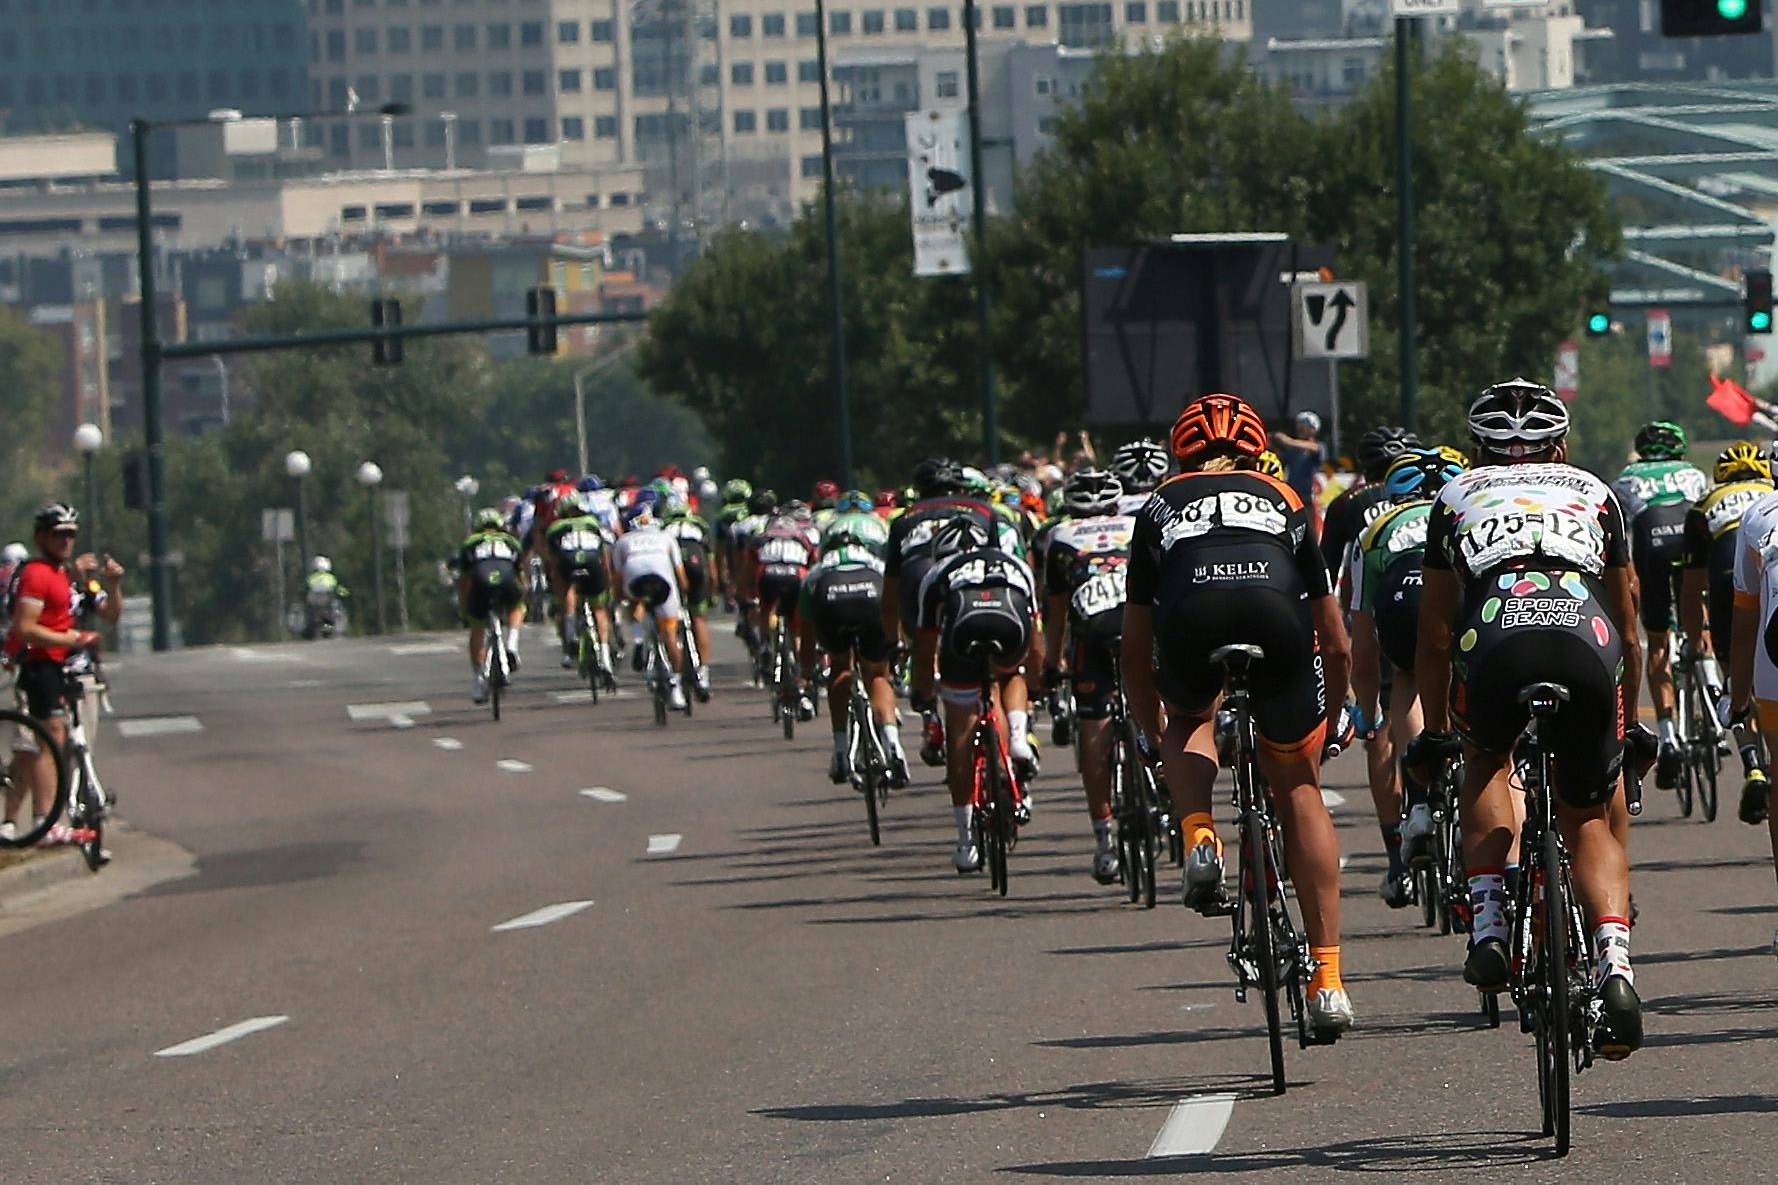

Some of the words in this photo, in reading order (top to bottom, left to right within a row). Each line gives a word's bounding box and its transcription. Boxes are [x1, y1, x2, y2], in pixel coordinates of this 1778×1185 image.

[1213, 561, 1269, 575] KELLY
[1505, 598, 1584, 613] SPORT
[1501, 612, 1581, 629] BEANS
